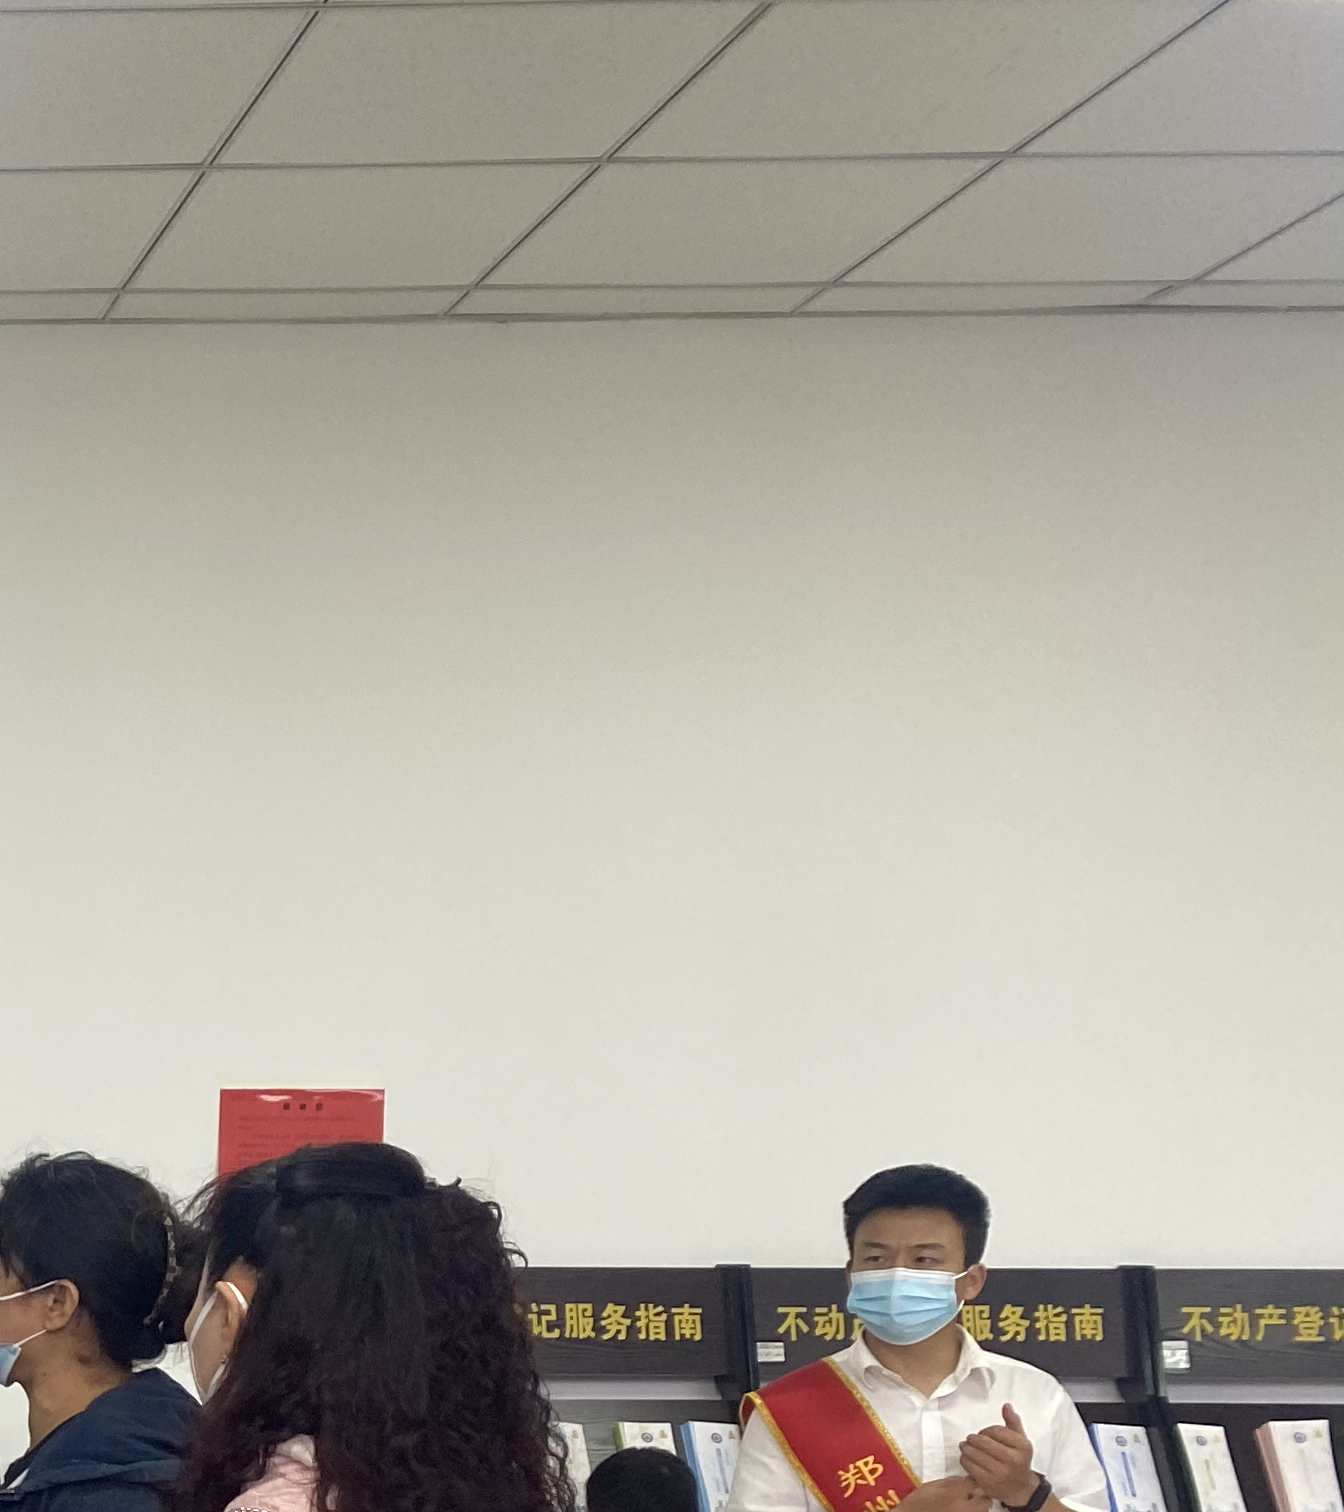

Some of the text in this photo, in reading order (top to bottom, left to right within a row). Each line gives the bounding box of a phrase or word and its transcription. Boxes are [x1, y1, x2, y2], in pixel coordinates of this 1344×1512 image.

[527, 1302, 704, 1342] 记服务指南
